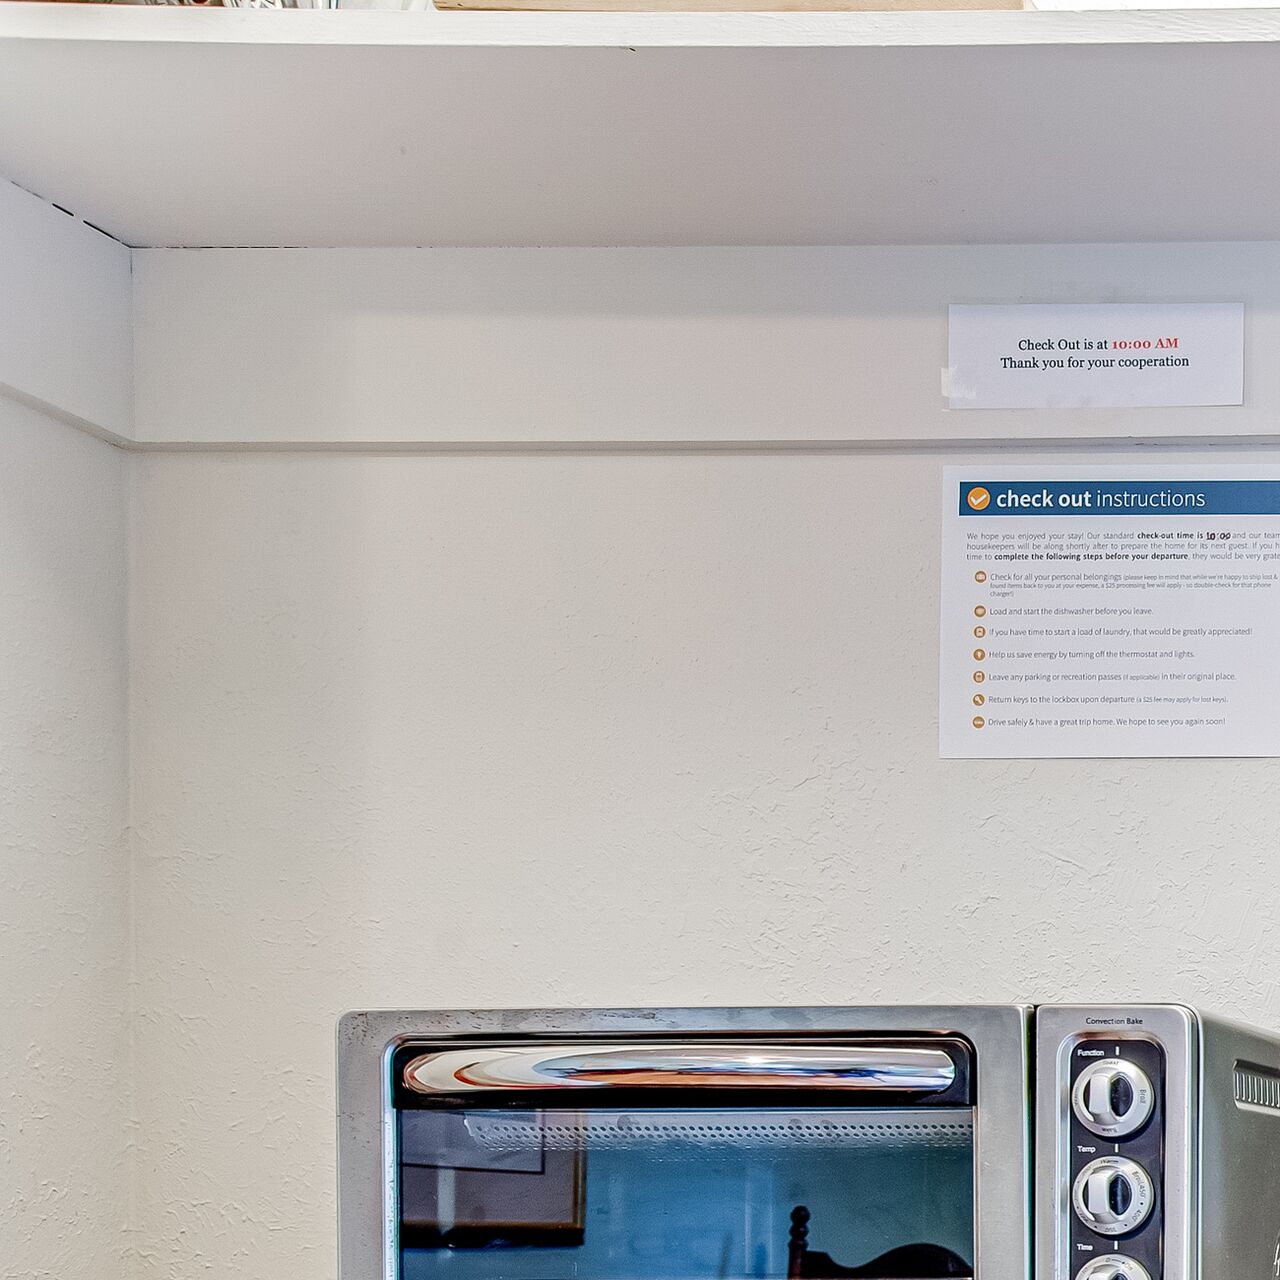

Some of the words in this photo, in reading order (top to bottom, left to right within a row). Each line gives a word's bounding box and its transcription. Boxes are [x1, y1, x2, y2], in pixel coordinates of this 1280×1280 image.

[1018, 339, 1055, 350] Check
[1058, 340, 1081, 350] Out
[1084, 339, 1093, 350] is
[1097, 340, 1108, 349] at
[1112, 341, 1151, 349] 10:00
[1155, 338, 1179, 348] AM
[1000, 357, 1039, 368] Thank
[1042, 359, 1064, 370] you
[1068, 356, 1085, 368] for
[1088, 358, 1115, 370] your
[1118, 356, 1189, 369] cooperation
[996, 490, 1054, 508] check
[1058, 491, 1092, 507] out
[1097, 490, 1205, 508] instructions
[994, 553, 1029, 561] complete
[1046, 553, 1081, 561] following
[1193, 553, 1207, 561] they
[1077, 1145, 1096, 1153] Temp
